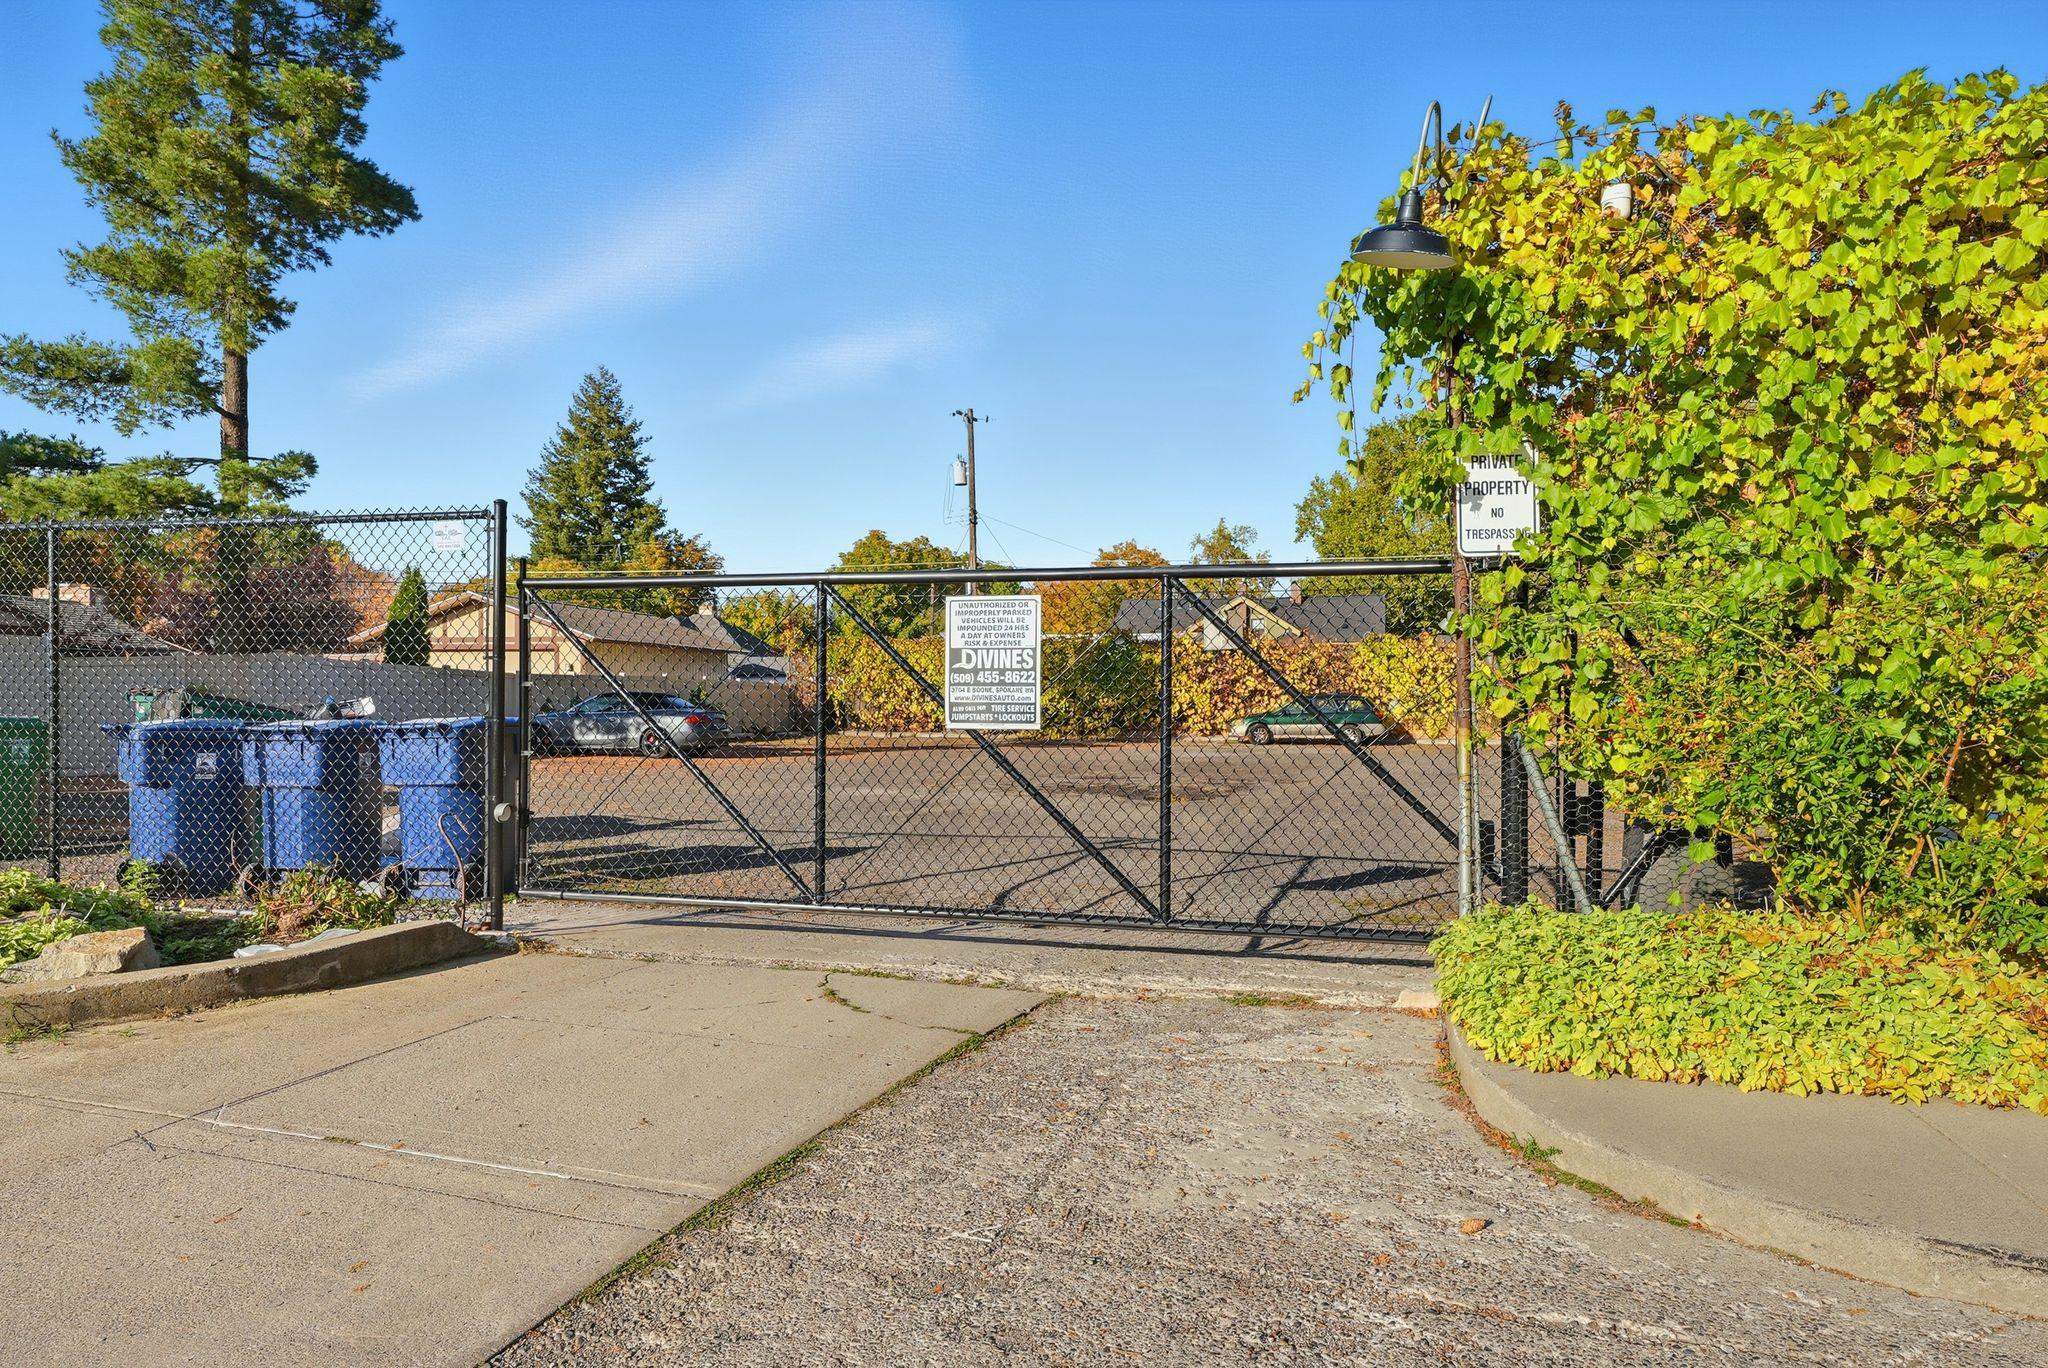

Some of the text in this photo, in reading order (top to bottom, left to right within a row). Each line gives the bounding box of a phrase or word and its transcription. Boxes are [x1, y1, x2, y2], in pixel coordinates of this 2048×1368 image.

[1465, 480, 1529, 496] PROPERTY
[1490, 507, 1504, 518] NO
[1465, 528, 1531, 540] TRESPASSG
[952, 648, 1034, 670] DIVINES
[950, 670, 1035, 684] (509) 455-8622
[951, 713, 1035, 721] JUMPSTARTS LOCKOUTS
